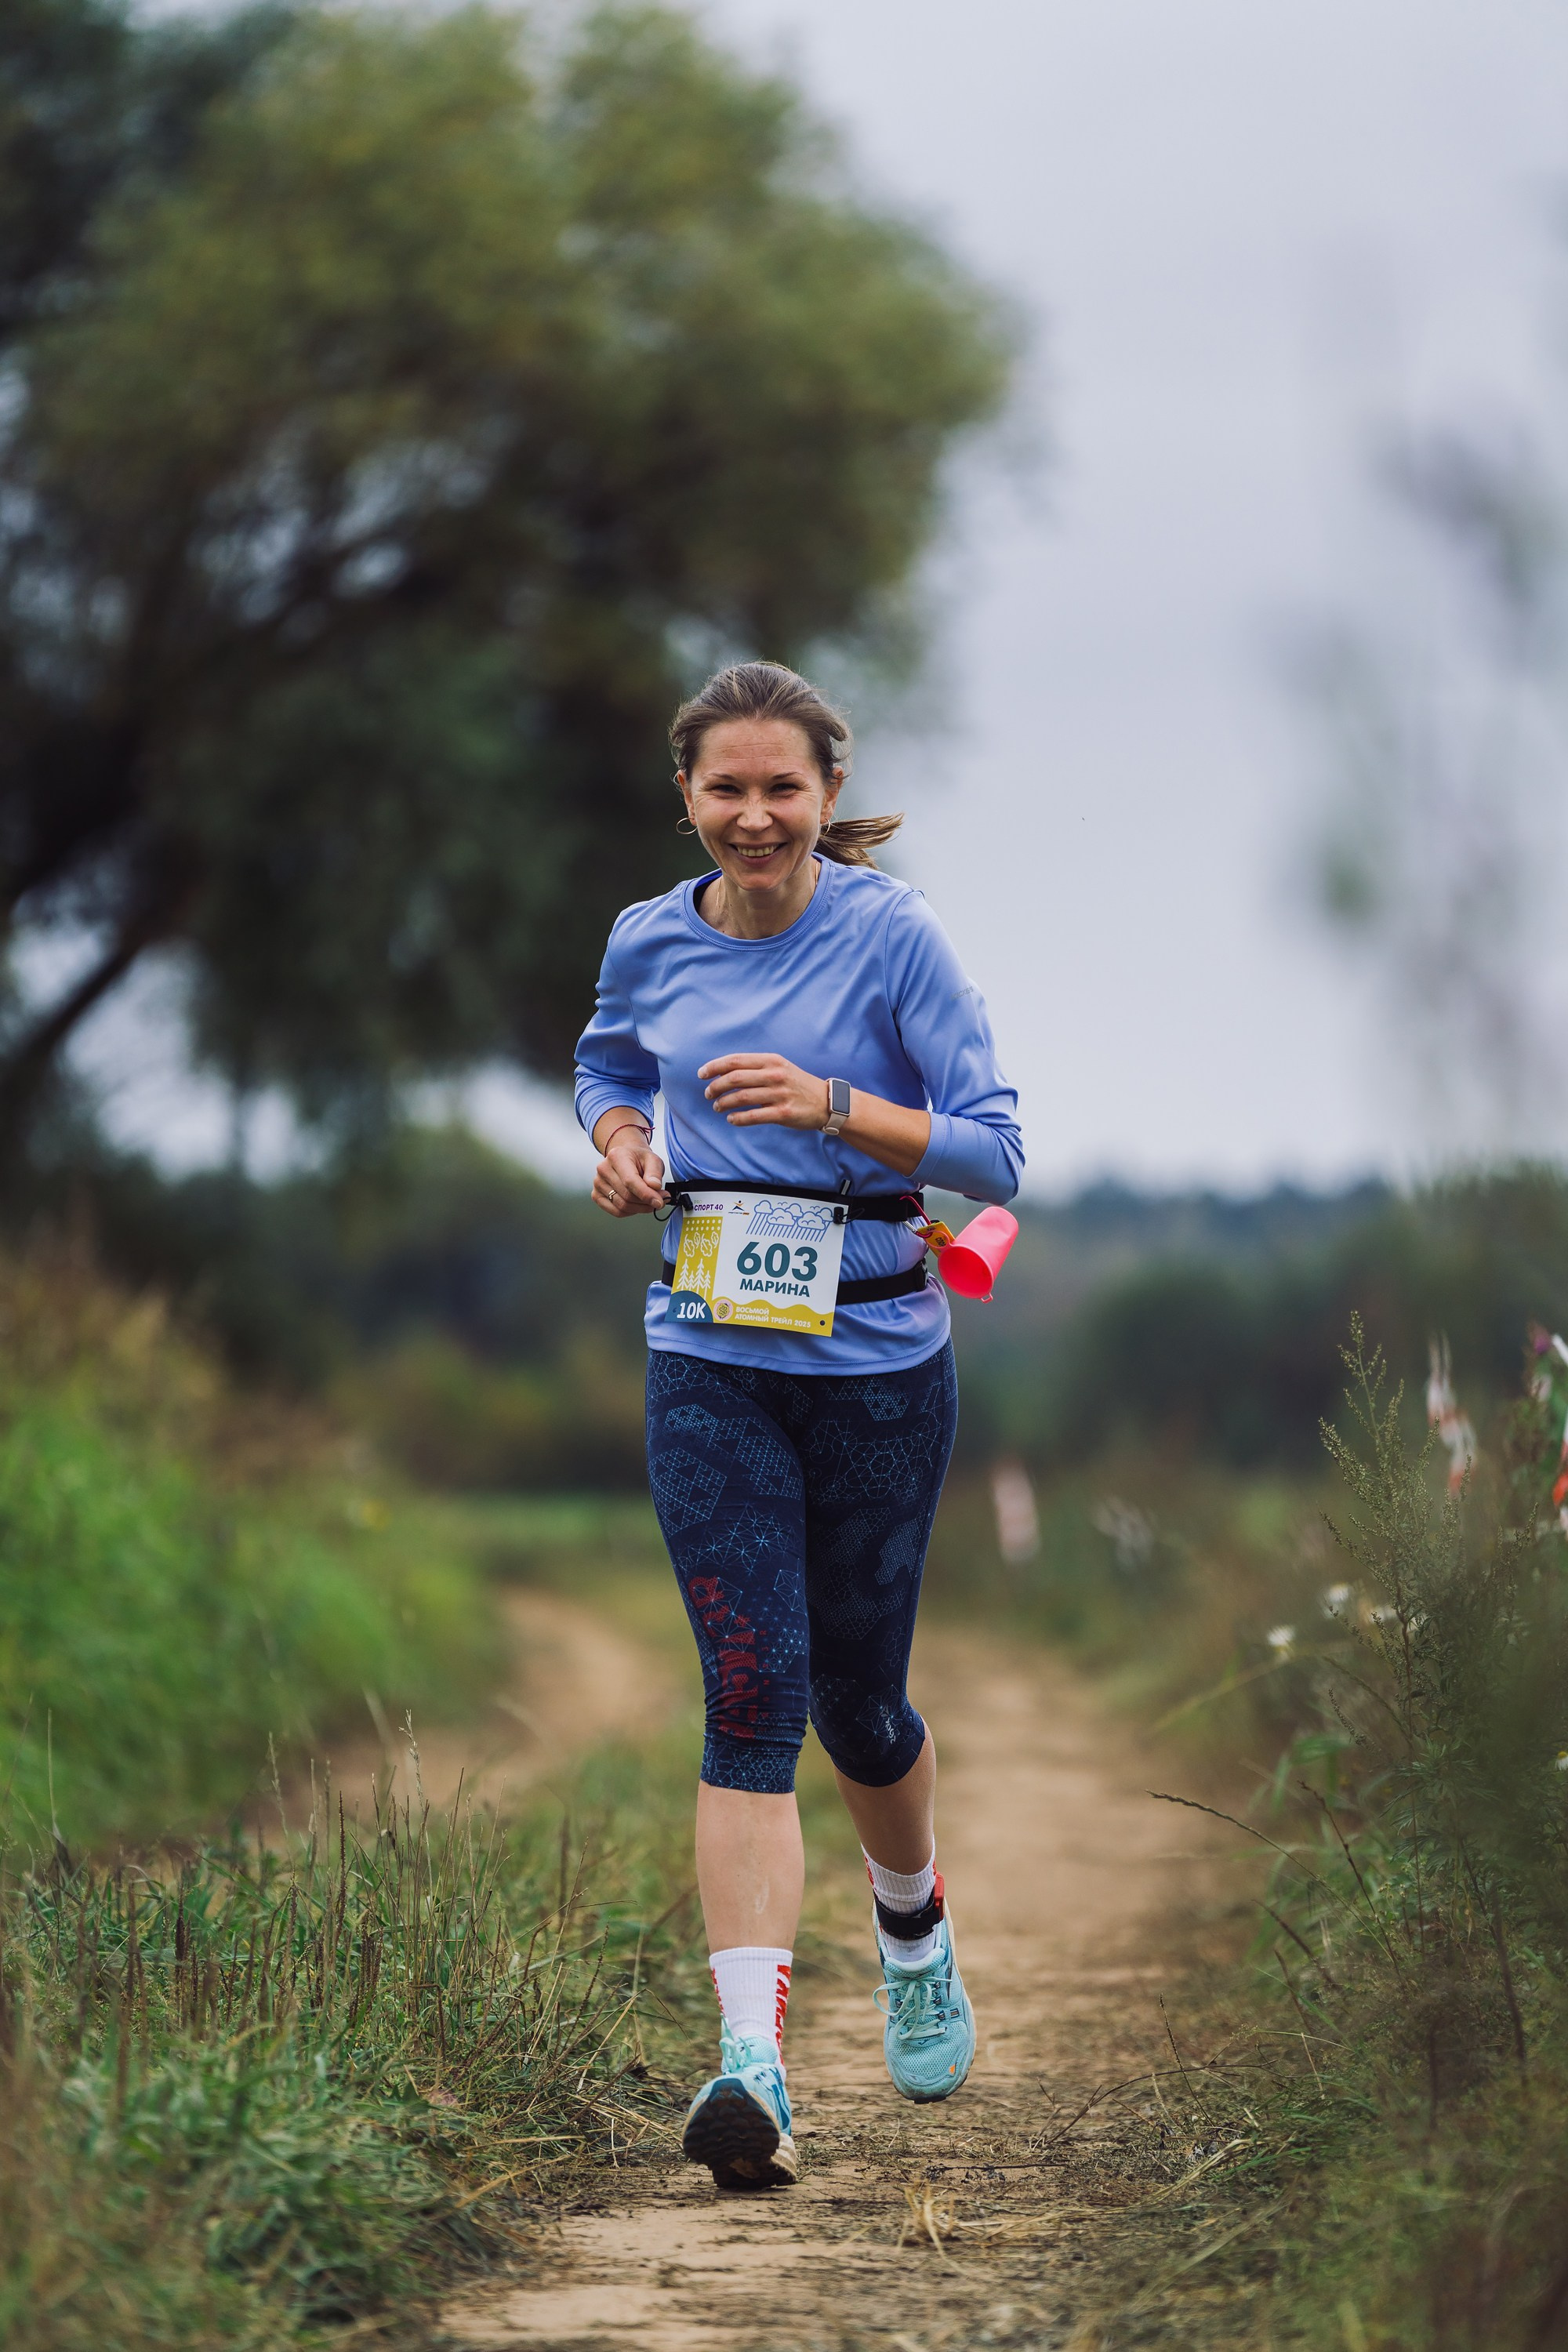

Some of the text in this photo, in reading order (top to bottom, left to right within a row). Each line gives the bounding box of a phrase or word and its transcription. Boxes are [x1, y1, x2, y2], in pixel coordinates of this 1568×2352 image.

[737, 1241, 818, 1282] 603
[739, 1278, 810, 1298] МАРИНА
[735, 1306, 769, 1316] ВОСЬМОЙ
[735, 1314, 811, 1328] АТОМНЫЙ ТРЕЙЛ 2025
